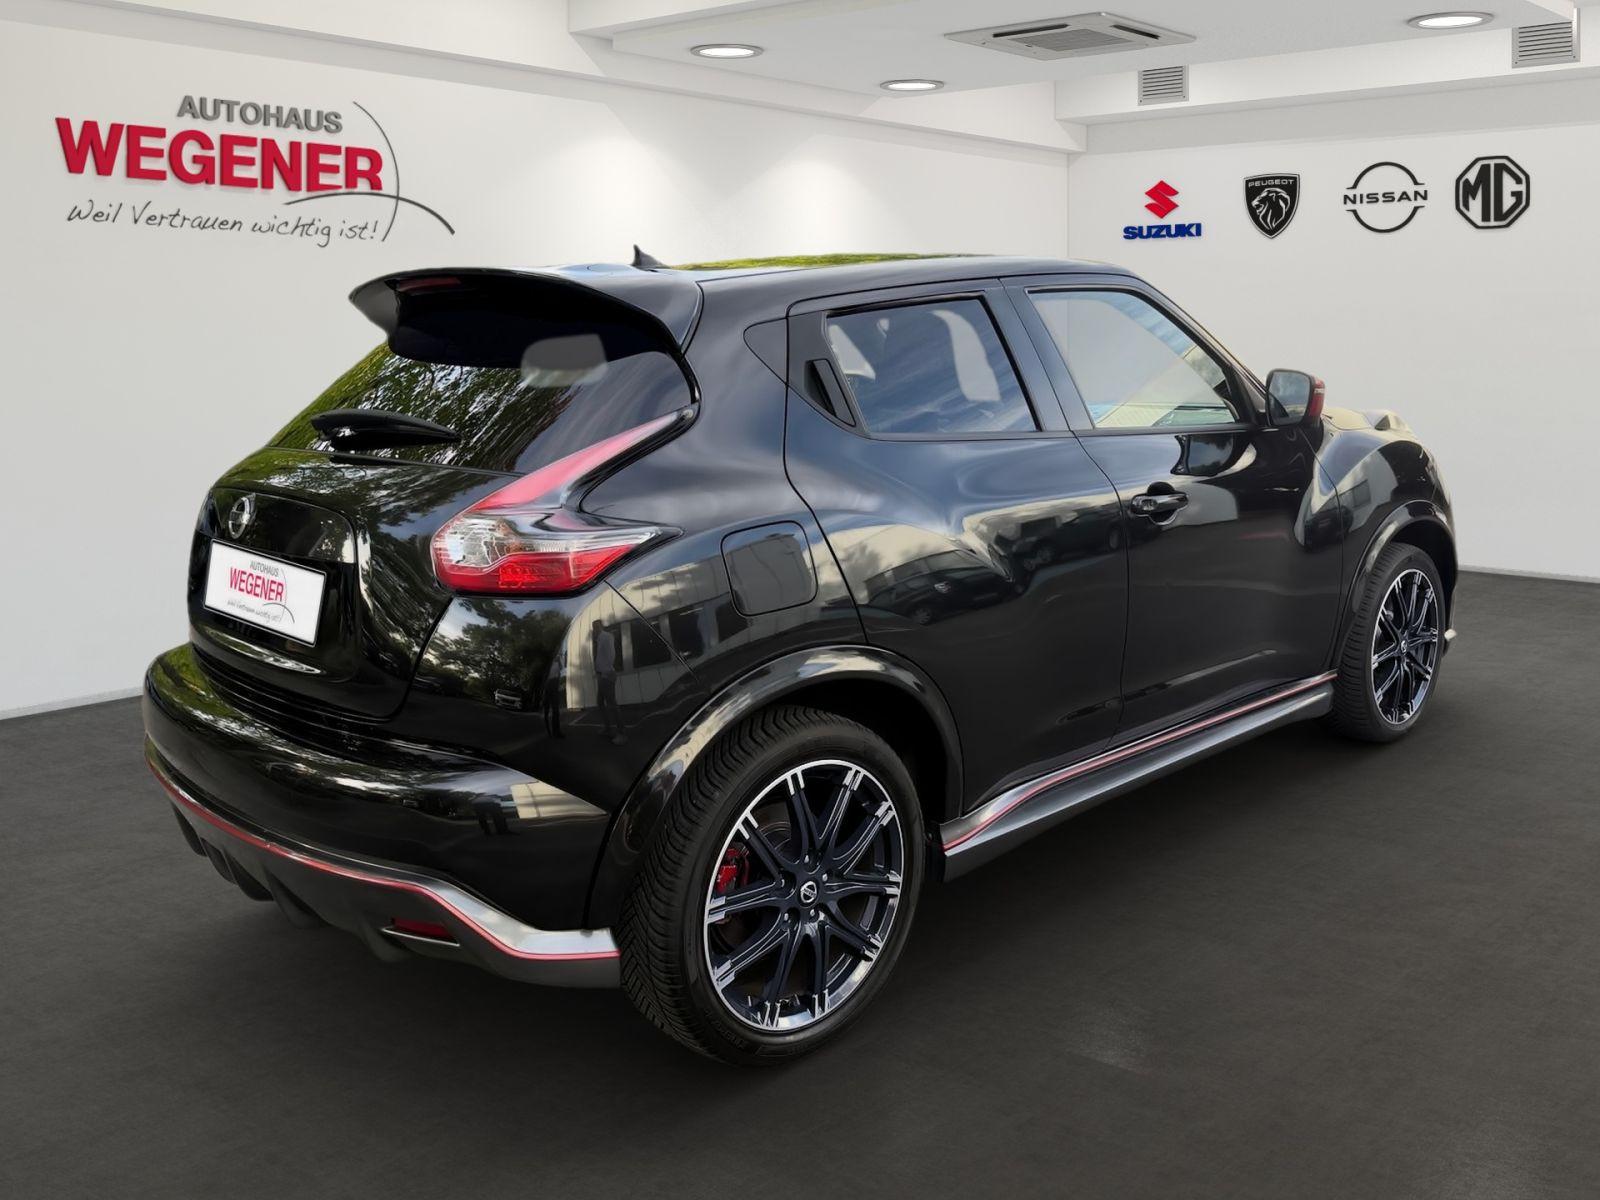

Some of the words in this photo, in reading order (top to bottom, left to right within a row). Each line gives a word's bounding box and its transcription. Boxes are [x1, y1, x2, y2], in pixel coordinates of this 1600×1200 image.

[176, 95, 343, 134] AUTOHAUS
[55, 117, 384, 193] WEGENER
[1248, 178, 1294, 188] PEUGEOT
[1343, 189, 1428, 206] NISSAN
[1462, 162, 1523, 222] MG
[67, 199, 123, 224] Weil
[132, 200, 243, 232] Vertrauen
[251, 214, 331, 248] wichtig
[339, 220, 379, 240] ist!
[1123, 222, 1202, 240] SUZUKI
[230, 567, 285, 602] WEGENER
[249, 560, 280, 578] AUTOHAUS
